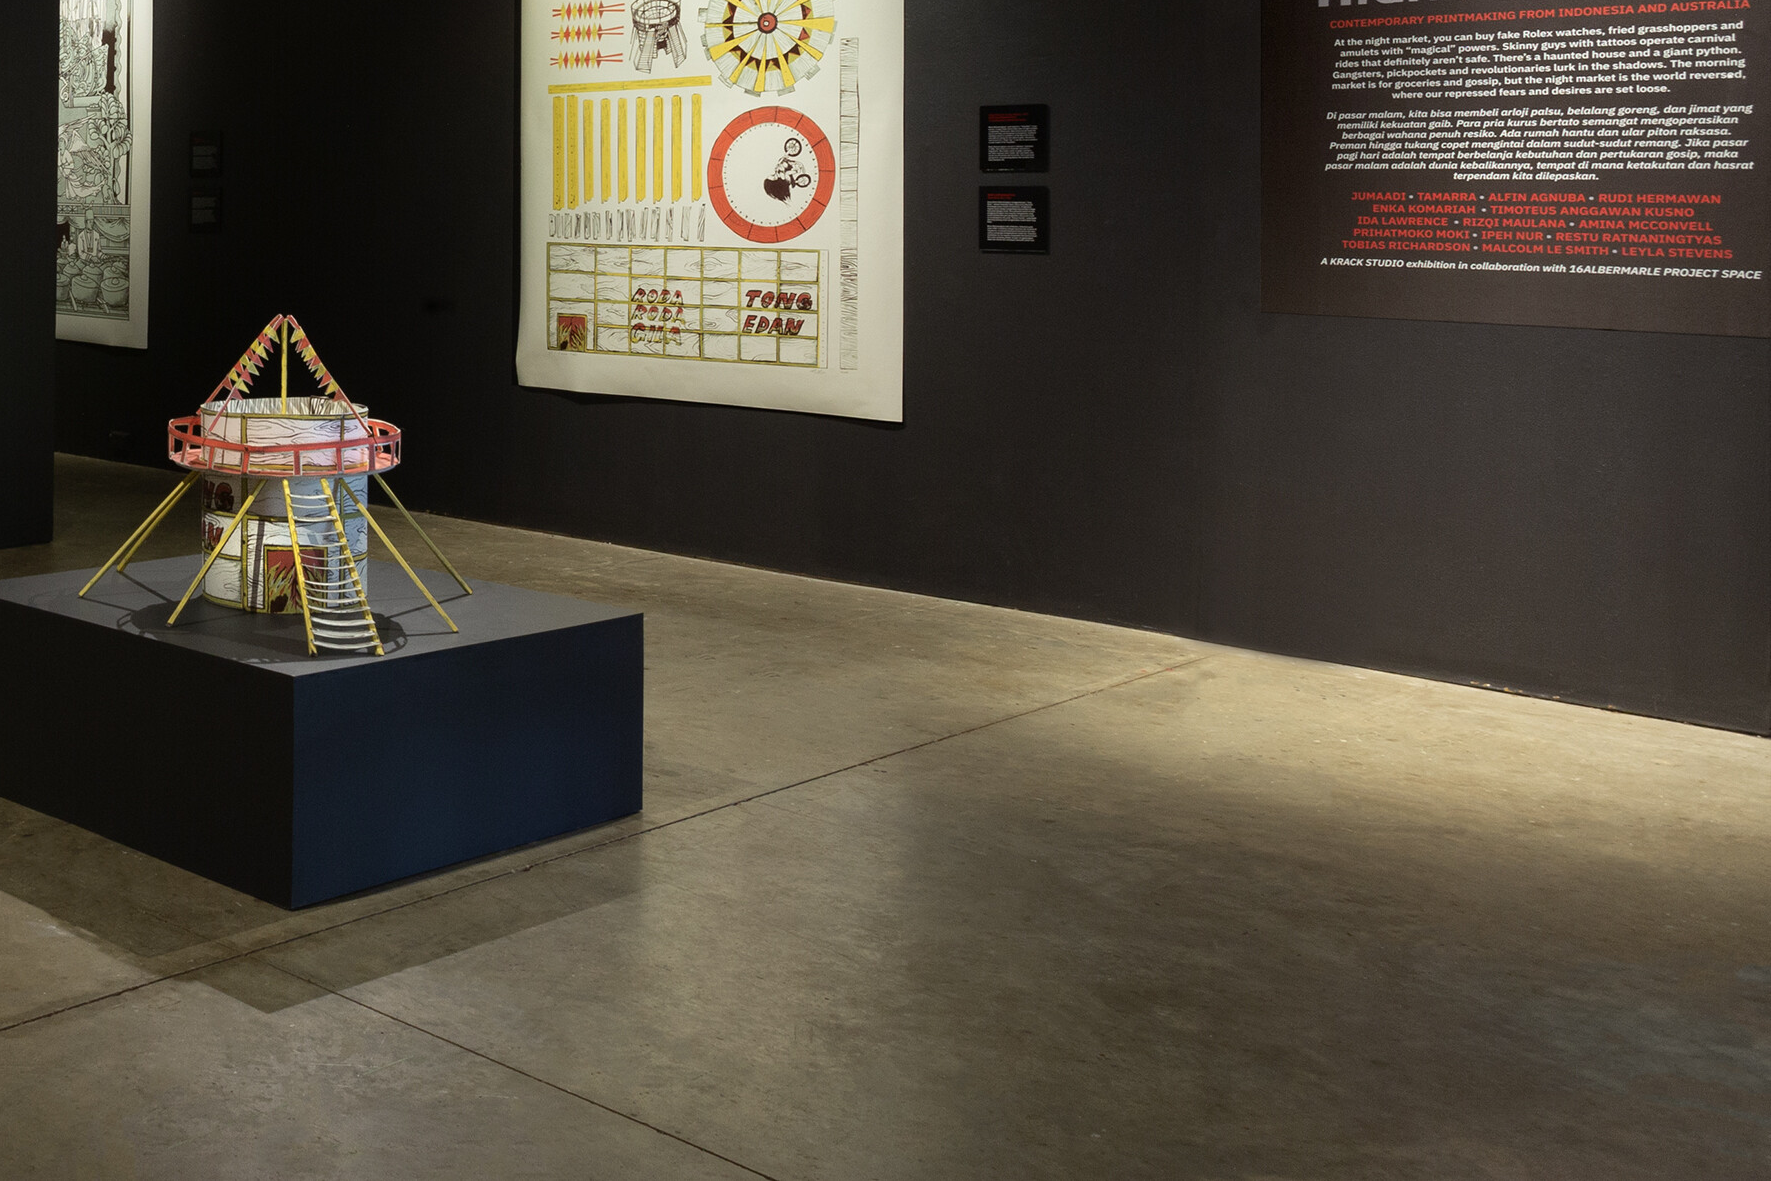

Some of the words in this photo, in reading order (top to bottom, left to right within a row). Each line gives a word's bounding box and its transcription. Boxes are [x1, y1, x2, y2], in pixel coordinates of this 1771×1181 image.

[1331, 17, 1425, 30] CONTEMPORARY
[1428, 12, 1516, 24] PRINTMAKING
[1519, 9, 1556, 19] FROM
[1558, 6, 1635, 17] INDONESIA
[1637, 4, 1667, 14] AND
[1670, 0, 1750, 12] AUSTRALIA
[1365, 37, 1390, 46] night
[1433, 36, 1452, 44] you
[1475, 32, 1495, 42] buy
[1497, 31, 1521, 39] fake
[1523, 30, 1554, 38] Rolex
[1555, 28, 1606, 37] watches,
[1608, 26, 1636, 34] fried
[1637, 24, 1718, 35] grasshoppers
[1720, 21, 1744, 30] and
[1458, 45, 1500, 54] powers.
[1502, 42, 1539, 51] Skinny
[1541, 42, 1567, 51] guys
[1569, 39, 1594, 48] with
[1639, 37, 1685, 47] operate
[1687, 34, 1736, 43] carnival
[1384, 58, 1431, 66] definitely
[1465, 55, 1490, 63] safe.
[1544, 51, 1590, 60] haunted
[1628, 49, 1651, 58] and
[1663, 48, 1694, 58] giant
[1696, 46, 1742, 57] python.
[1333, 72, 1384, 80] Gangsters,
[1387, 69, 1447, 78] pickpockets
[1449, 67, 1469, 75] and
[1471, 65, 1552, 74] revolutionaries
[1554, 63, 1576, 72] lurk
[1578, 63, 1589, 71] in
[1590, 62, 1610, 71] the
[1612, 61, 1667, 70] shadows.
[1670, 60, 1693, 68] The
[1695, 58, 1746, 68] morning
[1445, 89, 1497, 99] repressed
[1498, 88, 1527, 96] fears
[1528, 87, 1549, 96] and
[1551, 86, 1593, 95] desires
[1636, 85, 1672, 93] loose.
[1428, 120, 1453, 130] gaib.
[1482, 119, 1505, 129] pria
[1539, 118, 1580, 126] bertato
[1582, 118, 1639, 127] semangat
[1640, 116, 1739, 126] mengoperasikan
[1342, 132, 1385, 140] berbagai
[1428, 130, 1461, 140] penuh
[1463, 130, 1497, 138] resiko.
[1499, 129, 1522, 138] Ada
[1523, 129, 1560, 137] rumah
[1561, 129, 1595, 137] hantu
[1596, 128, 1619, 137] dan
[1621, 128, 1646, 136] ular
[1647, 128, 1678, 138] piton
[1680, 128, 1732, 136] raksasa.
[1336, 152, 1358, 161] pagi
[1419, 152, 1456, 161] tempat
[1457, 151, 1514, 160] berbelanja
[1515, 150, 1574, 159] kebutuhan
[1575, 150, 1598, 159] dan
[1599, 150, 1664, 160] pertukaran
[1666, 150, 1701, 160] gosip,
[1704, 150, 1739, 158] maka
[1453, 172, 1510, 181] terpendam
[1512, 172, 1533, 180] kita
[1535, 172, 1599, 181] dilepaskan.
[1352, 192, 1406, 201] JUMAADI
[1417, 192, 1477, 201] TAMARRA
[1488, 193, 1527, 202] ALFIN
[1530, 193, 1586, 203] AGNUBA
[1598, 194, 1633, 203] RUDI
[1636, 194, 1721, 204] HERMAWAN
[1373, 205, 1405, 213] ENKA
[1408, 205, 1476, 214] KOMARIAH
[1490, 206, 1557, 215] TIMOTEUS
[1560, 207, 1641, 216] ANGGAWAN
[1644, 208, 1695, 217] KUSNO
[1358, 216, 1378, 224] IDA
[1382, 217, 1448, 226] LAWRENCE
[1463, 218, 1500, 229] RIZQI
[1502, 219, 1566, 228] MAULANA
[1578, 220, 1625, 229] AMINA
[1628, 221, 1713, 231] MCCONVELL
[1354, 229, 1433, 238] PRIHATMOKO
[1436, 230, 1470, 239] MOKI
[1481, 231, 1513, 240] IPEH
[1516, 232, 1544, 241] NUR
[1556, 232, 1599, 242] RESTU
[1602, 234, 1722, 245] RATNANINGTYAS
[1342, 241, 1386, 249] TOBIAS
[1389, 242, 1470, 251] RICHARDSON
[1482, 244, 1544, 254] MALCOLM
[1547, 245, 1562, 254] LE
[1565, 246, 1609, 255] SMITH
[1621, 247, 1665, 257] LEYLA
[1668, 248, 1733, 259] STEVENS
[1365, 259, 1404, 267] STUDIO
[1406, 260, 1456, 269] exhibition
[1458, 261, 1468, 270] in
[1470, 262, 1540, 272] collaboration
[1542, 264, 1567, 273] with
[1569, 265, 1662, 276] 16ALBERMARLE
[1663, 268, 1720, 278] PROJECT
[1721, 270, 1762, 280] SPACE
[631, 287, 685, 306] RODA
[745, 289, 813, 311] TONG
[742, 314, 805, 336] EDAN
